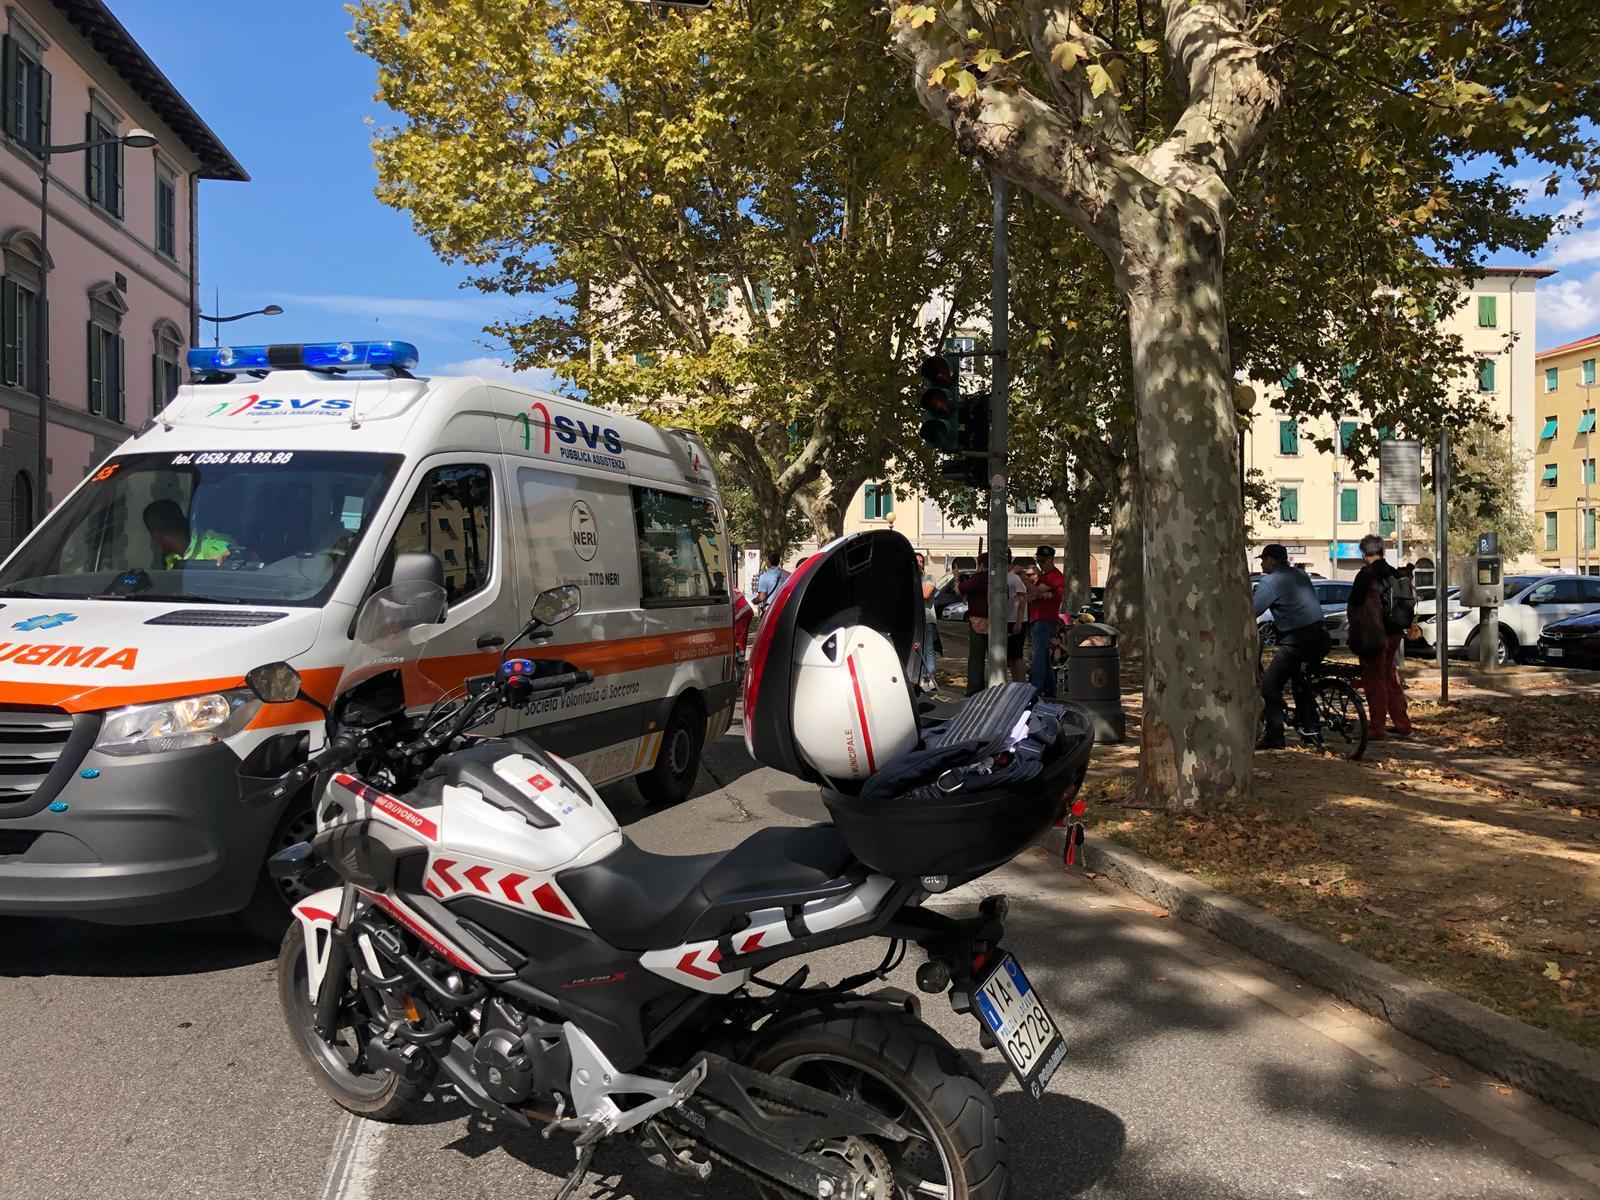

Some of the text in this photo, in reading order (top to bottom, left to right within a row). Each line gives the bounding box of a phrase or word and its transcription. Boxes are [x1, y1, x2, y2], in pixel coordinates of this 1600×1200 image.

[253, 399, 353, 410] SVS
[554, 415, 623, 455] SVS
[171, 452, 294, 465] tel. 0586 88.88.88
[560, 447, 626, 471] PUBBLICA ASSISTENZA
[573, 531, 597, 546] NERI
[589, 572, 604, 586] TITO
[605, 572, 620, 586] NERI
[560, 687, 599, 709] Volontaria
[601, 684, 609, 700] di
[609, 681, 640, 699] Soccorso
[392, 804, 423, 826] LIVORNO
[986, 977, 1014, 1014] YA
[1001, 994, 1034, 1038] POLIZIA LOCALE
[1007, 1005, 1050, 1070] 03728
